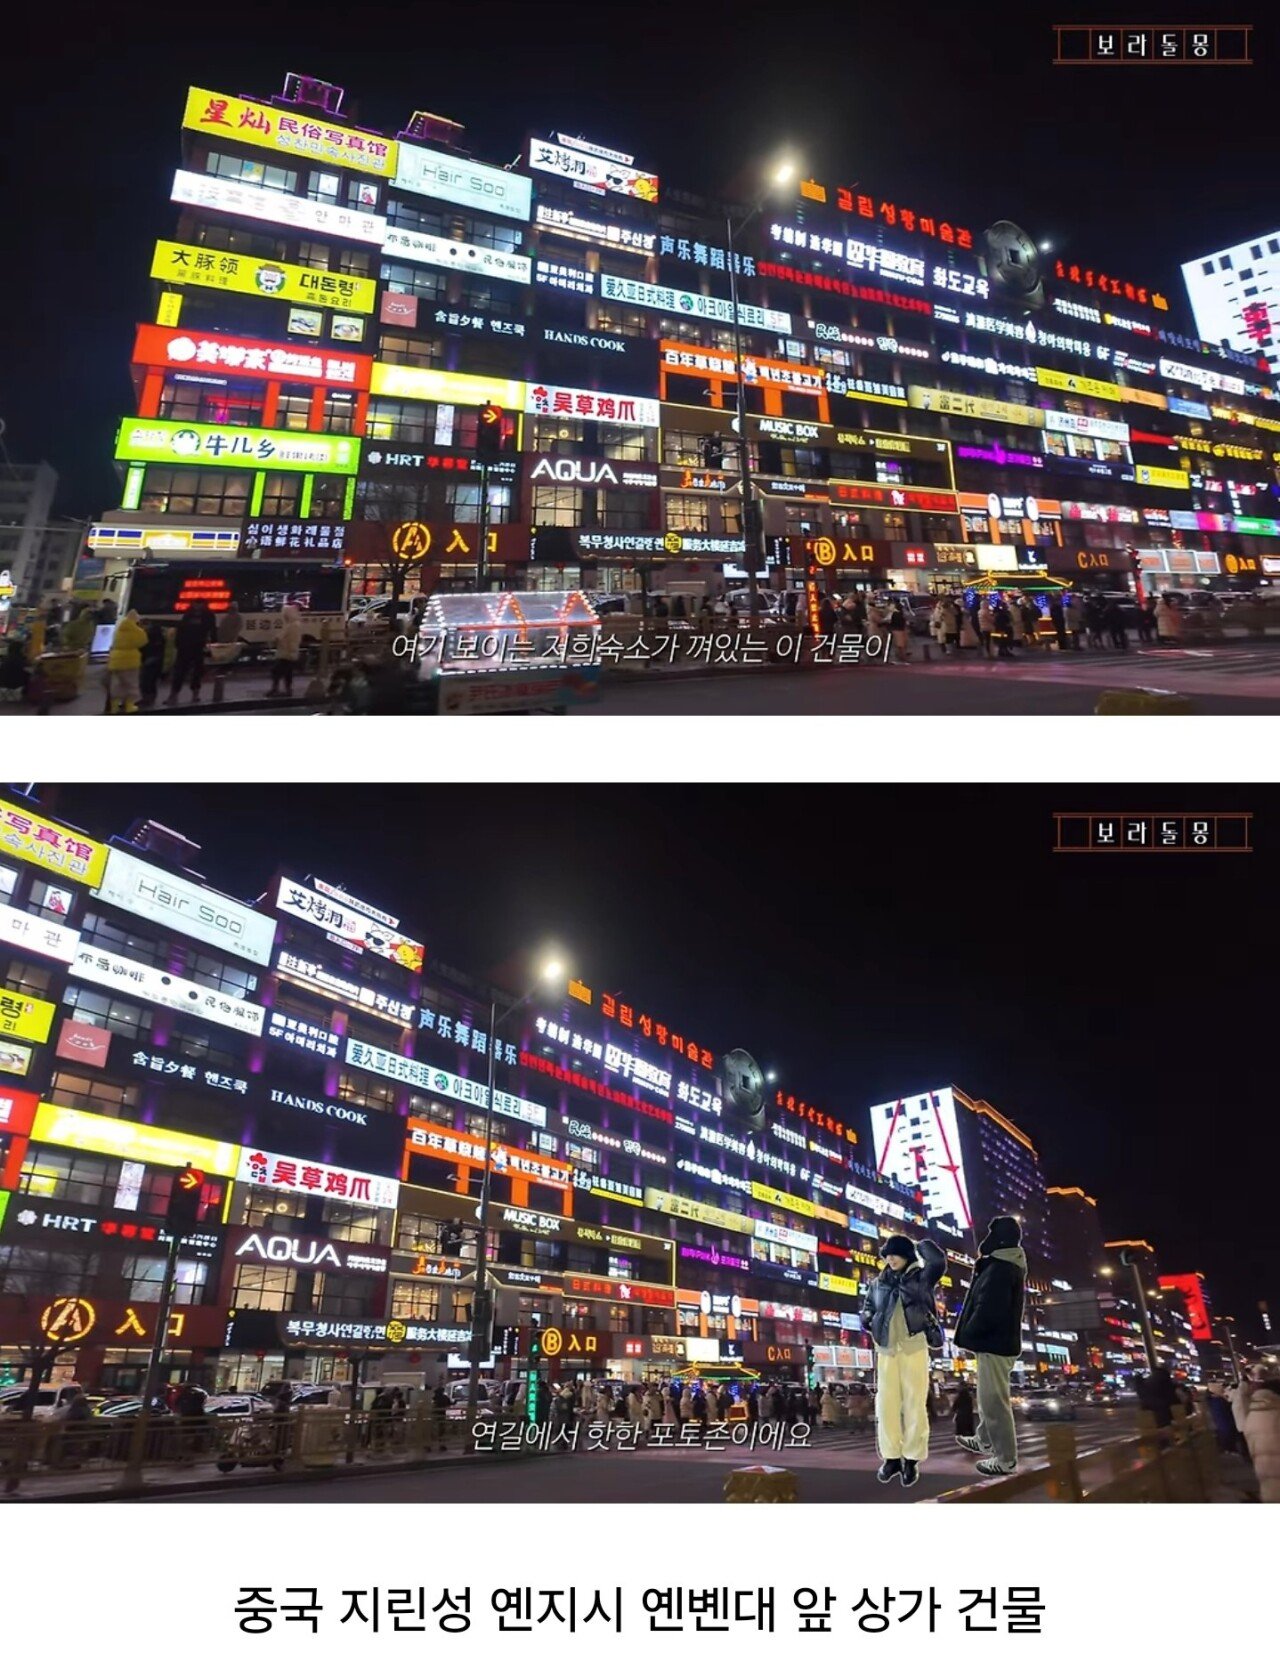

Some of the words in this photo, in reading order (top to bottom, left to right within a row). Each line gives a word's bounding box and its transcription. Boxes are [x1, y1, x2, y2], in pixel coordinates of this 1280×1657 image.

[422, 164, 461, 184] Hair
[469, 175, 507, 199] Soo
[544, 328, 589, 347] HANDS
[590, 337, 627, 353] COOK
[796, 423, 819, 439] BOX
[386, 452, 425, 468] HRT
[530, 458, 620, 485] AQUA
[842, 543, 874, 562] 入口
[138, 878, 190, 909] Hair
[198, 904, 242, 935] Soo
[271, 1088, 324, 1115] HANDS
[326, 1105, 368, 1126] COOK
[235, 1233, 341, 1267] AQUA
